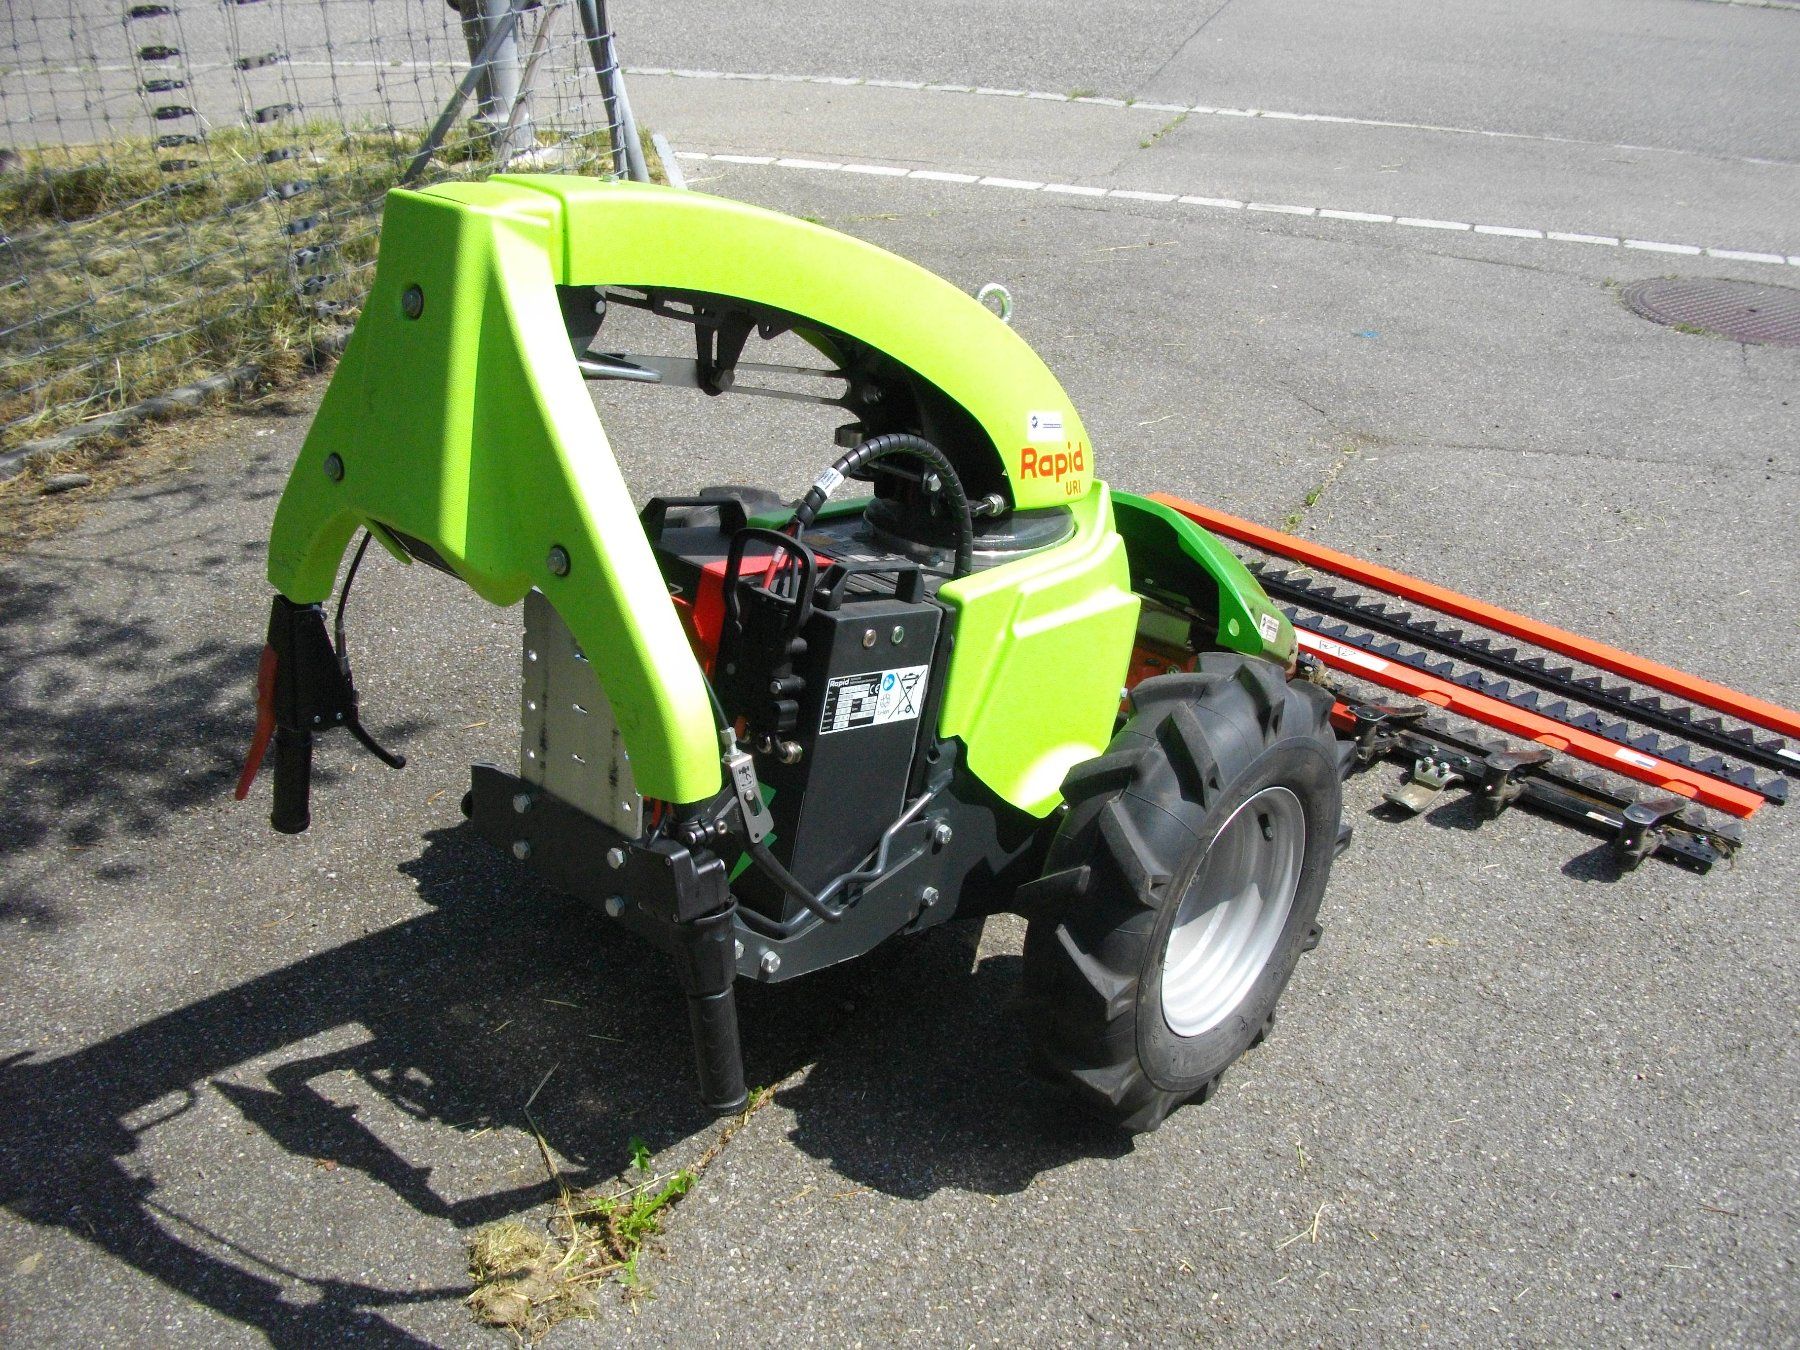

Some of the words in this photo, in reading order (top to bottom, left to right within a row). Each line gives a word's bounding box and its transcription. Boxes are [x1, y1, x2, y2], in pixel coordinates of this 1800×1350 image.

[1020, 441, 1084, 483] Rapid
[1066, 480, 1081, 495] URI
[829, 678, 850, 687] Rapid
